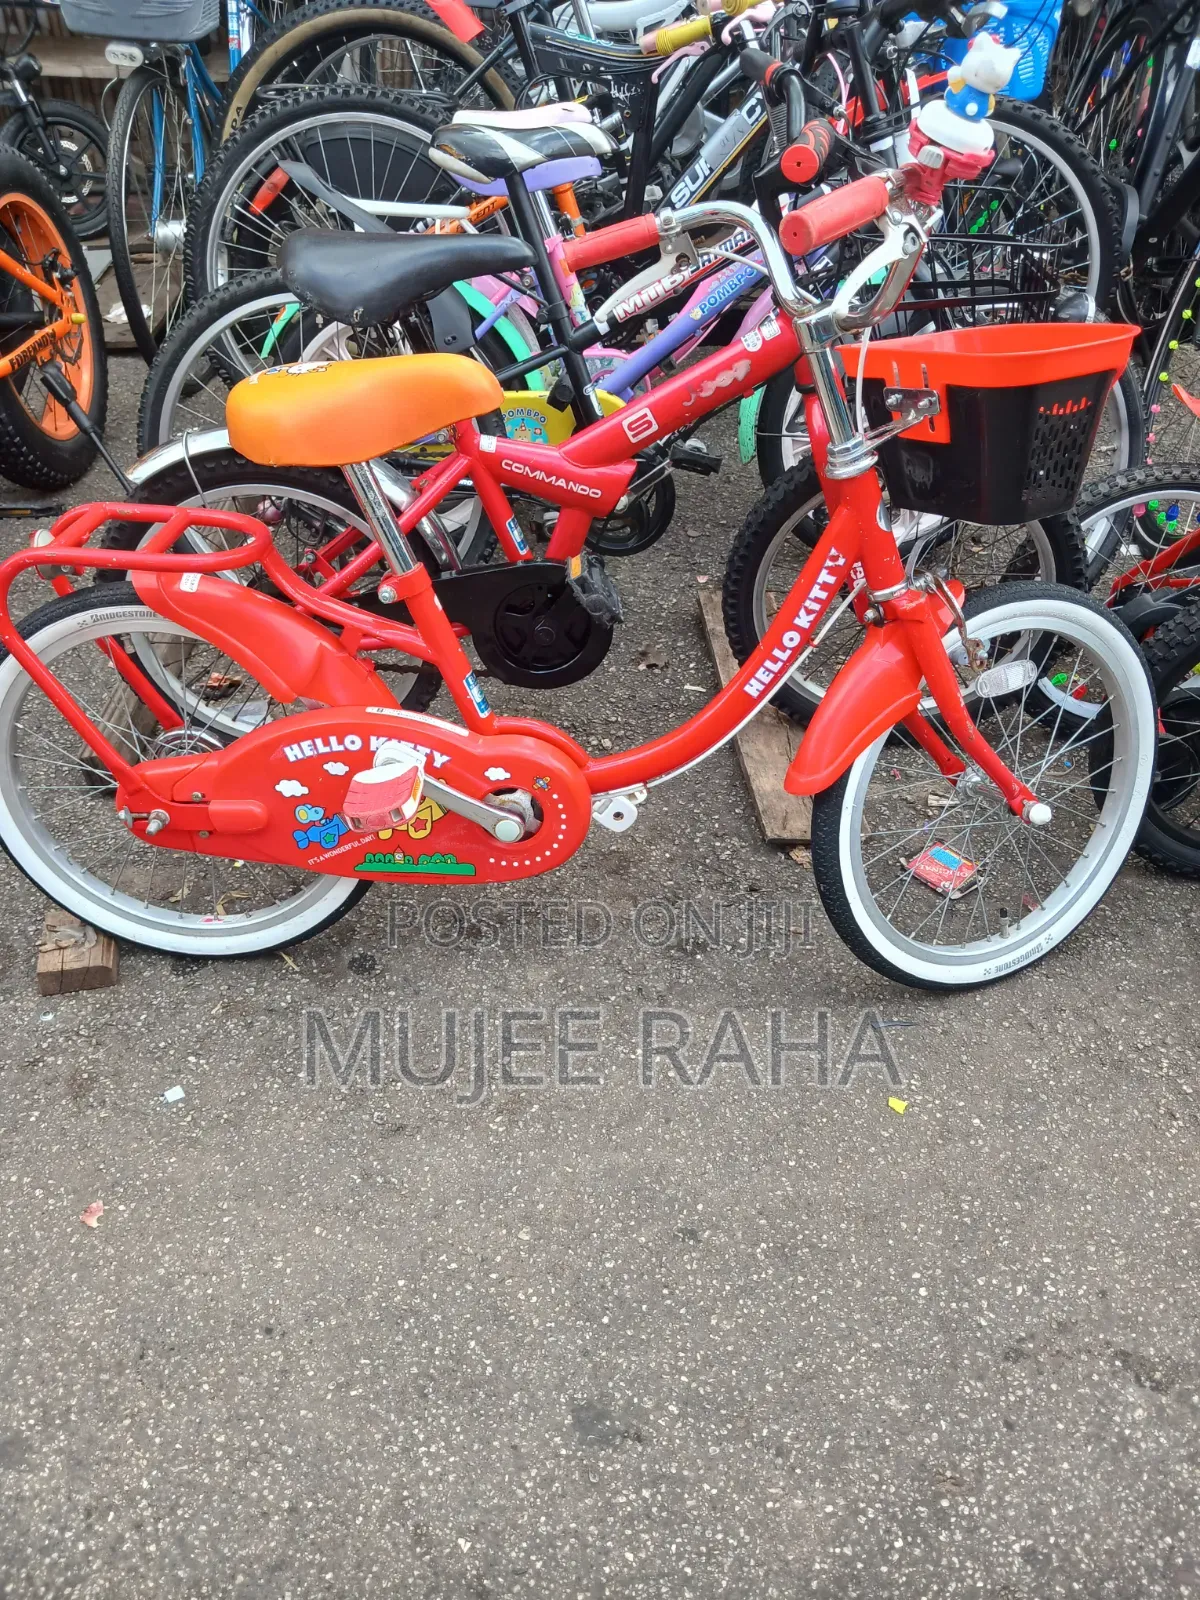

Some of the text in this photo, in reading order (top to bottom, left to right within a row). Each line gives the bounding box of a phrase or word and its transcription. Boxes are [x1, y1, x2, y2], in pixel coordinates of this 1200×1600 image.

[625, 411, 655, 441] S
[501, 459, 602, 499] COMMANDO
[743, 546, 847, 699] HELLO KITTY
[283, 733, 363, 763] HELLO
[323, 840, 361, 859] WONDERFUL
